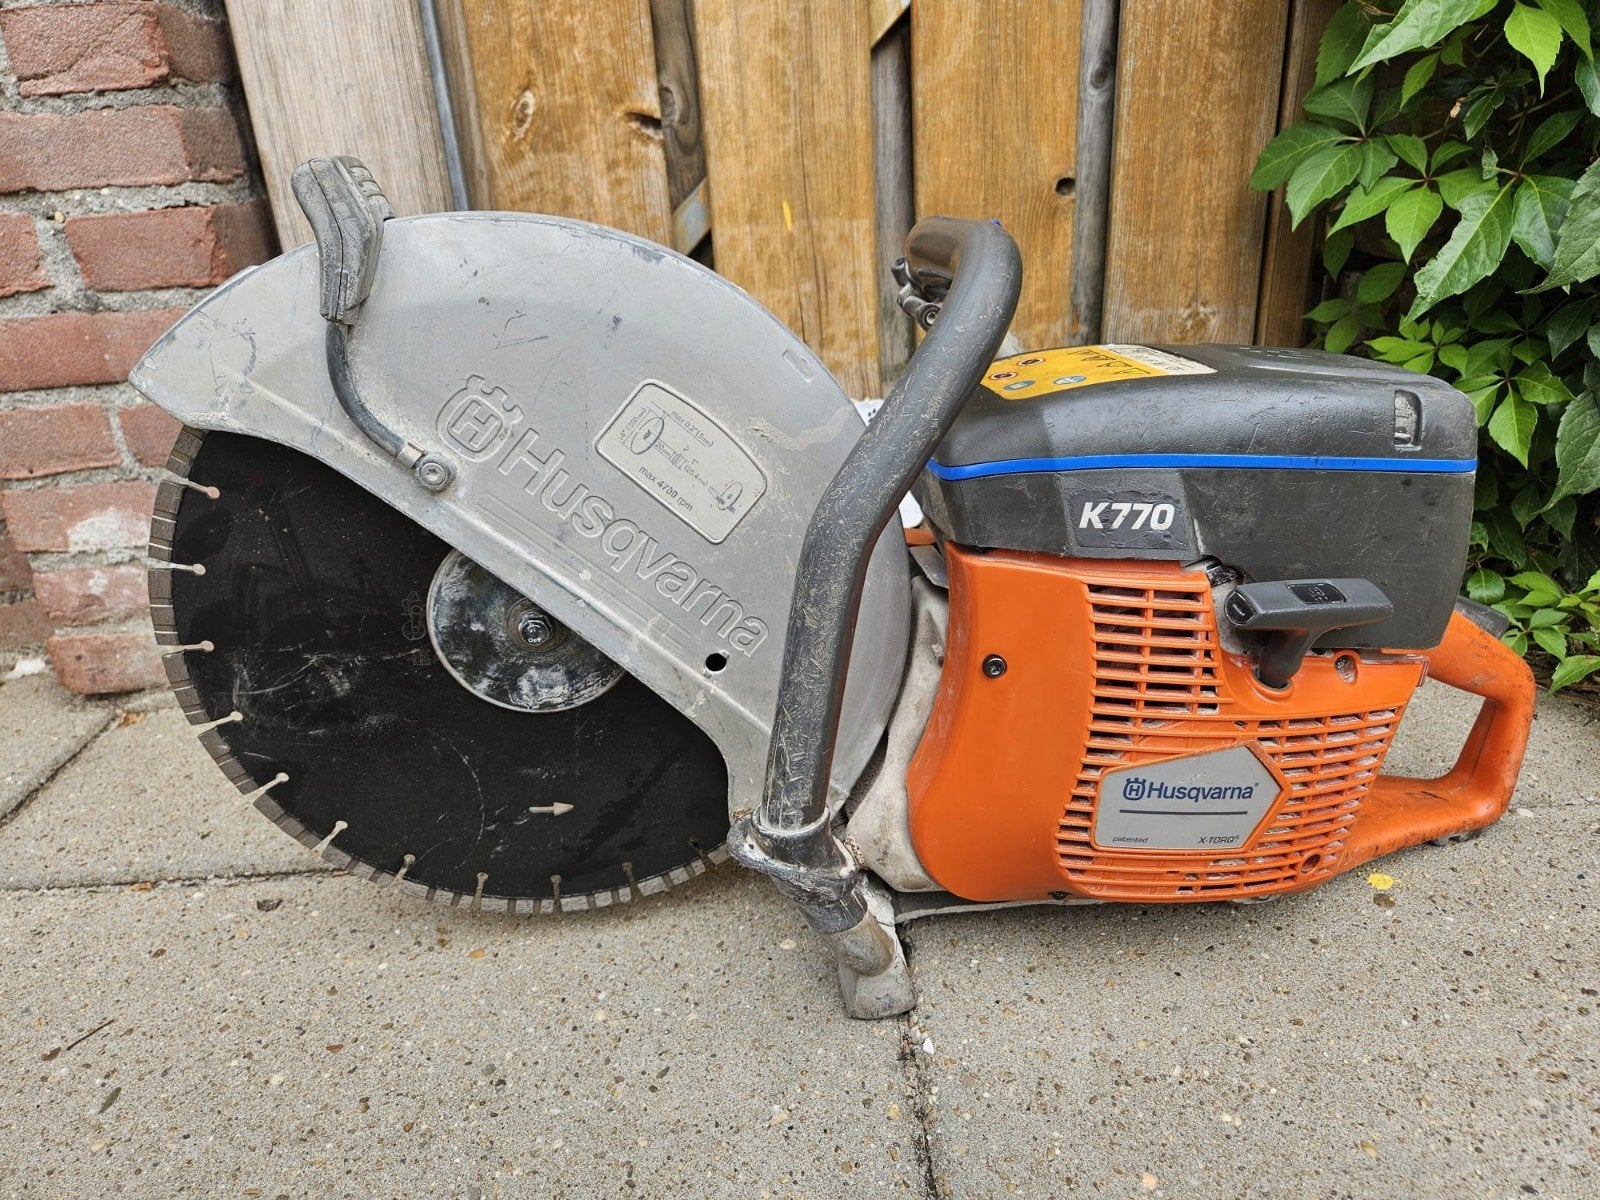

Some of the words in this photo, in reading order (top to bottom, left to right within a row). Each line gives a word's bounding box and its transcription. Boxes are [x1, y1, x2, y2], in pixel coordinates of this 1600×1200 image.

[639, 466, 656, 483] max
[677, 496, 693, 512] rpm
[1079, 501, 1175, 531] K770
[499, 427, 769, 657] Husqvarna
[1112, 836, 1149, 844] patented
